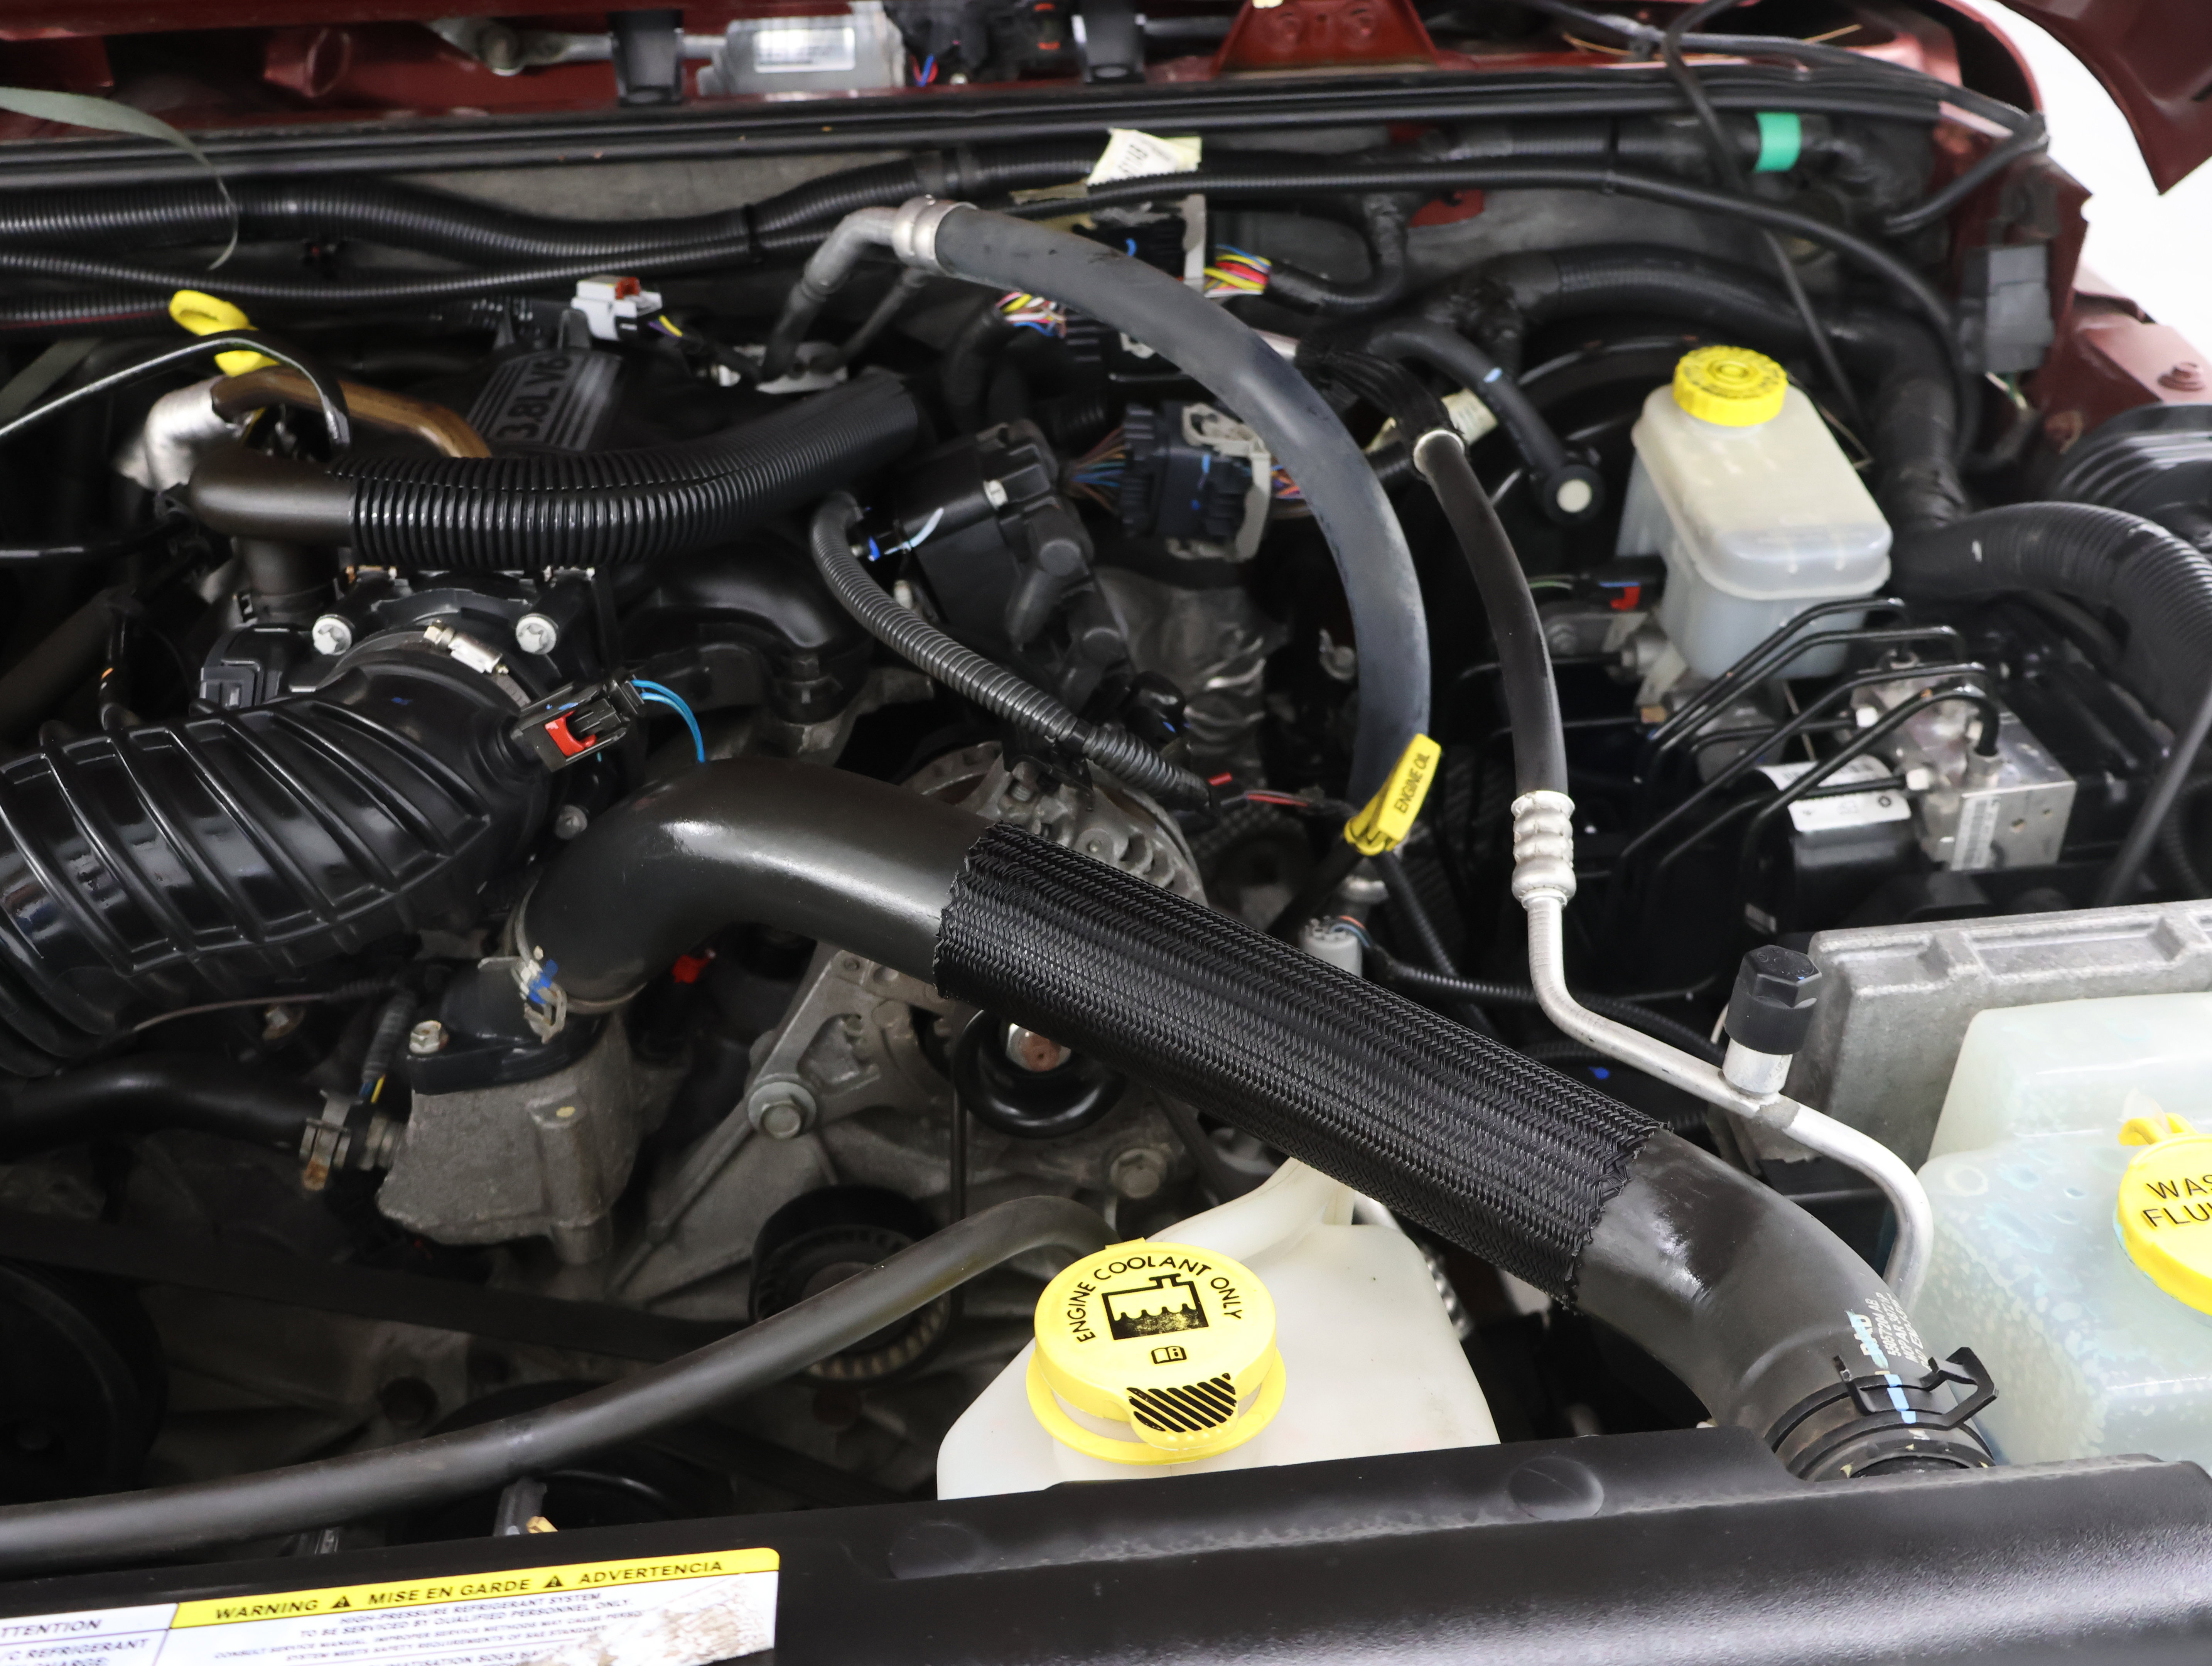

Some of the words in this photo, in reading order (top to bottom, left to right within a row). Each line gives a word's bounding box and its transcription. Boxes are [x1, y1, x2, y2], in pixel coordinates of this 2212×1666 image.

[525, 357, 571, 385] V6
[496, 386, 561, 438] 3.8L
[1395, 769, 1422, 813] ENGINE
[1414, 753, 1430, 770] OIL
[1067, 1281, 1096, 1342] ENGINE
[1093, 1256, 1212, 1281] COOLANT
[1210, 1276, 1243, 1319] ONLY
[1865, 1298, 1883, 1313] AB
[1851, 1314, 1882, 1356] RAD
[1893, 1324, 1919, 1364] MOPAR
[578, 1561, 723, 1585] ADVERTENCIA
[368, 1589, 420, 1605] MISE
[427, 1587, 454, 1600] EN
[460, 1579, 530, 1596] GARDE
[216, 1599, 319, 1619] WARNING
[301, 1629, 317, 1638] TO
[322, 1627, 338, 1636] BE
[342, 1621, 409, 1634] SERVICED
[413, 1619, 427, 1627] BY
[434, 1612, 506, 1626] QUALIFIED
[511, 1604, 589, 1617] PERSONNEL
[339, 1607, 448, 1624] HIGH-PRESSURE
[453, 1598, 544, 1614] REFRIGERANT
[0, 1619, 102, 1638] TTENTION
[27, 1638, 150, 1658] REFRIGERANT
